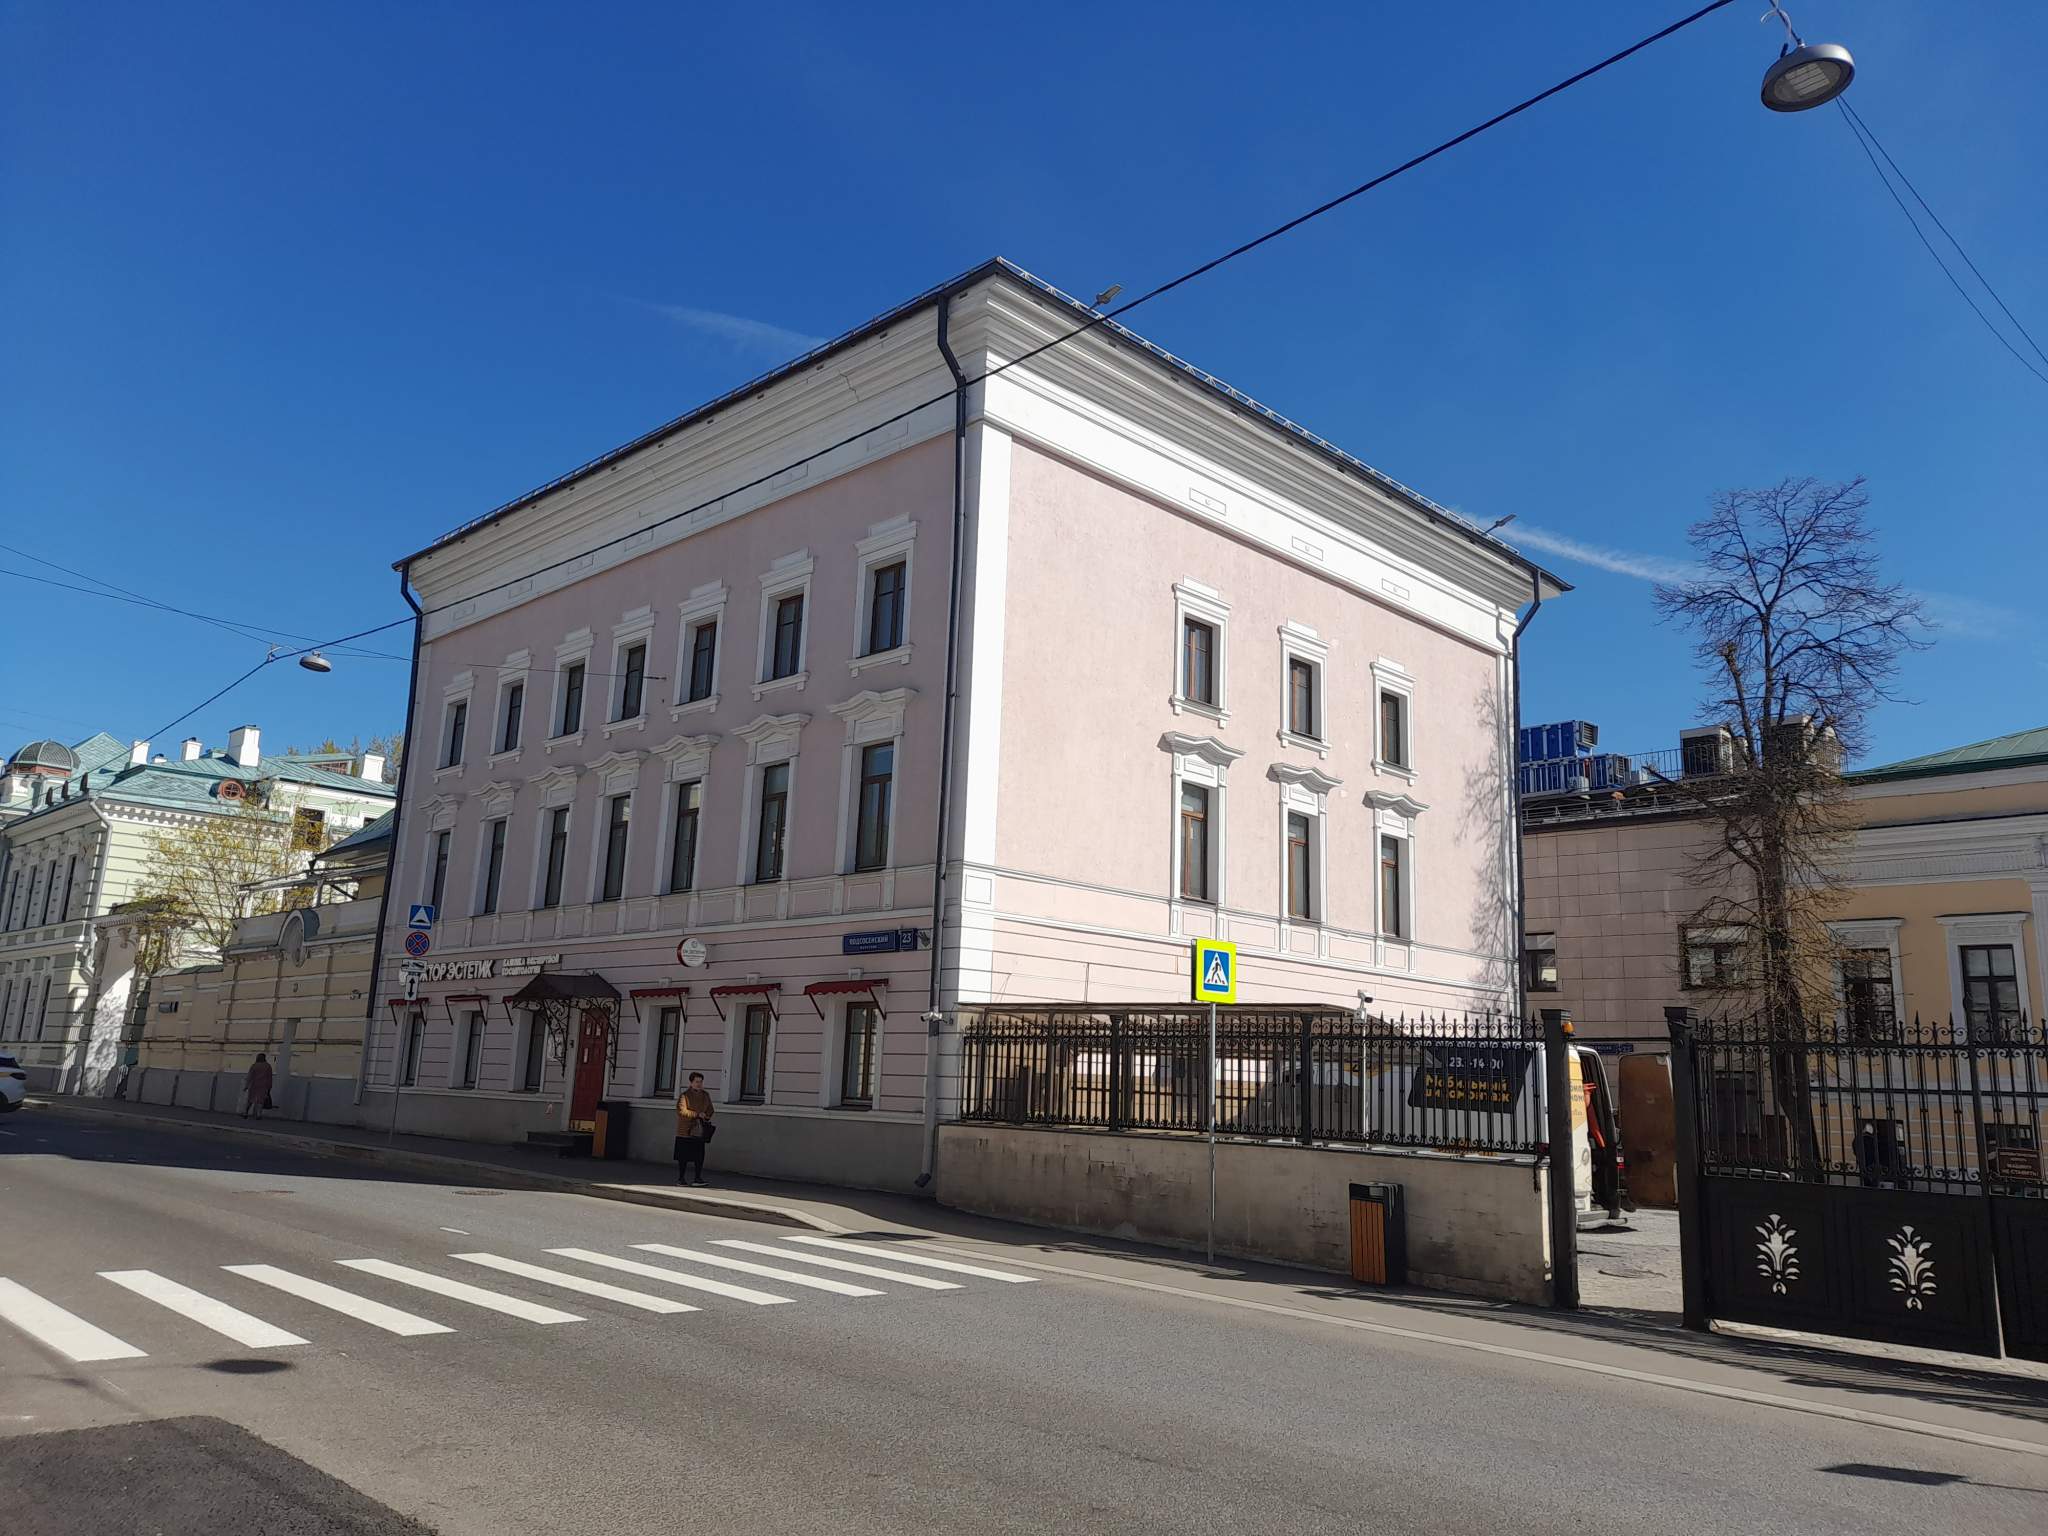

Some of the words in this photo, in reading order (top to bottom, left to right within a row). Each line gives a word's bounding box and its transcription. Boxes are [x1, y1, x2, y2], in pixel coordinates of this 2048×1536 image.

[902, 932, 911, 943] 23
[399, 963, 446, 986] КТОР
[447, 960, 493, 980] ЭСТЕТИК
[1425, 1074, 1507, 1091] Мобиьный
